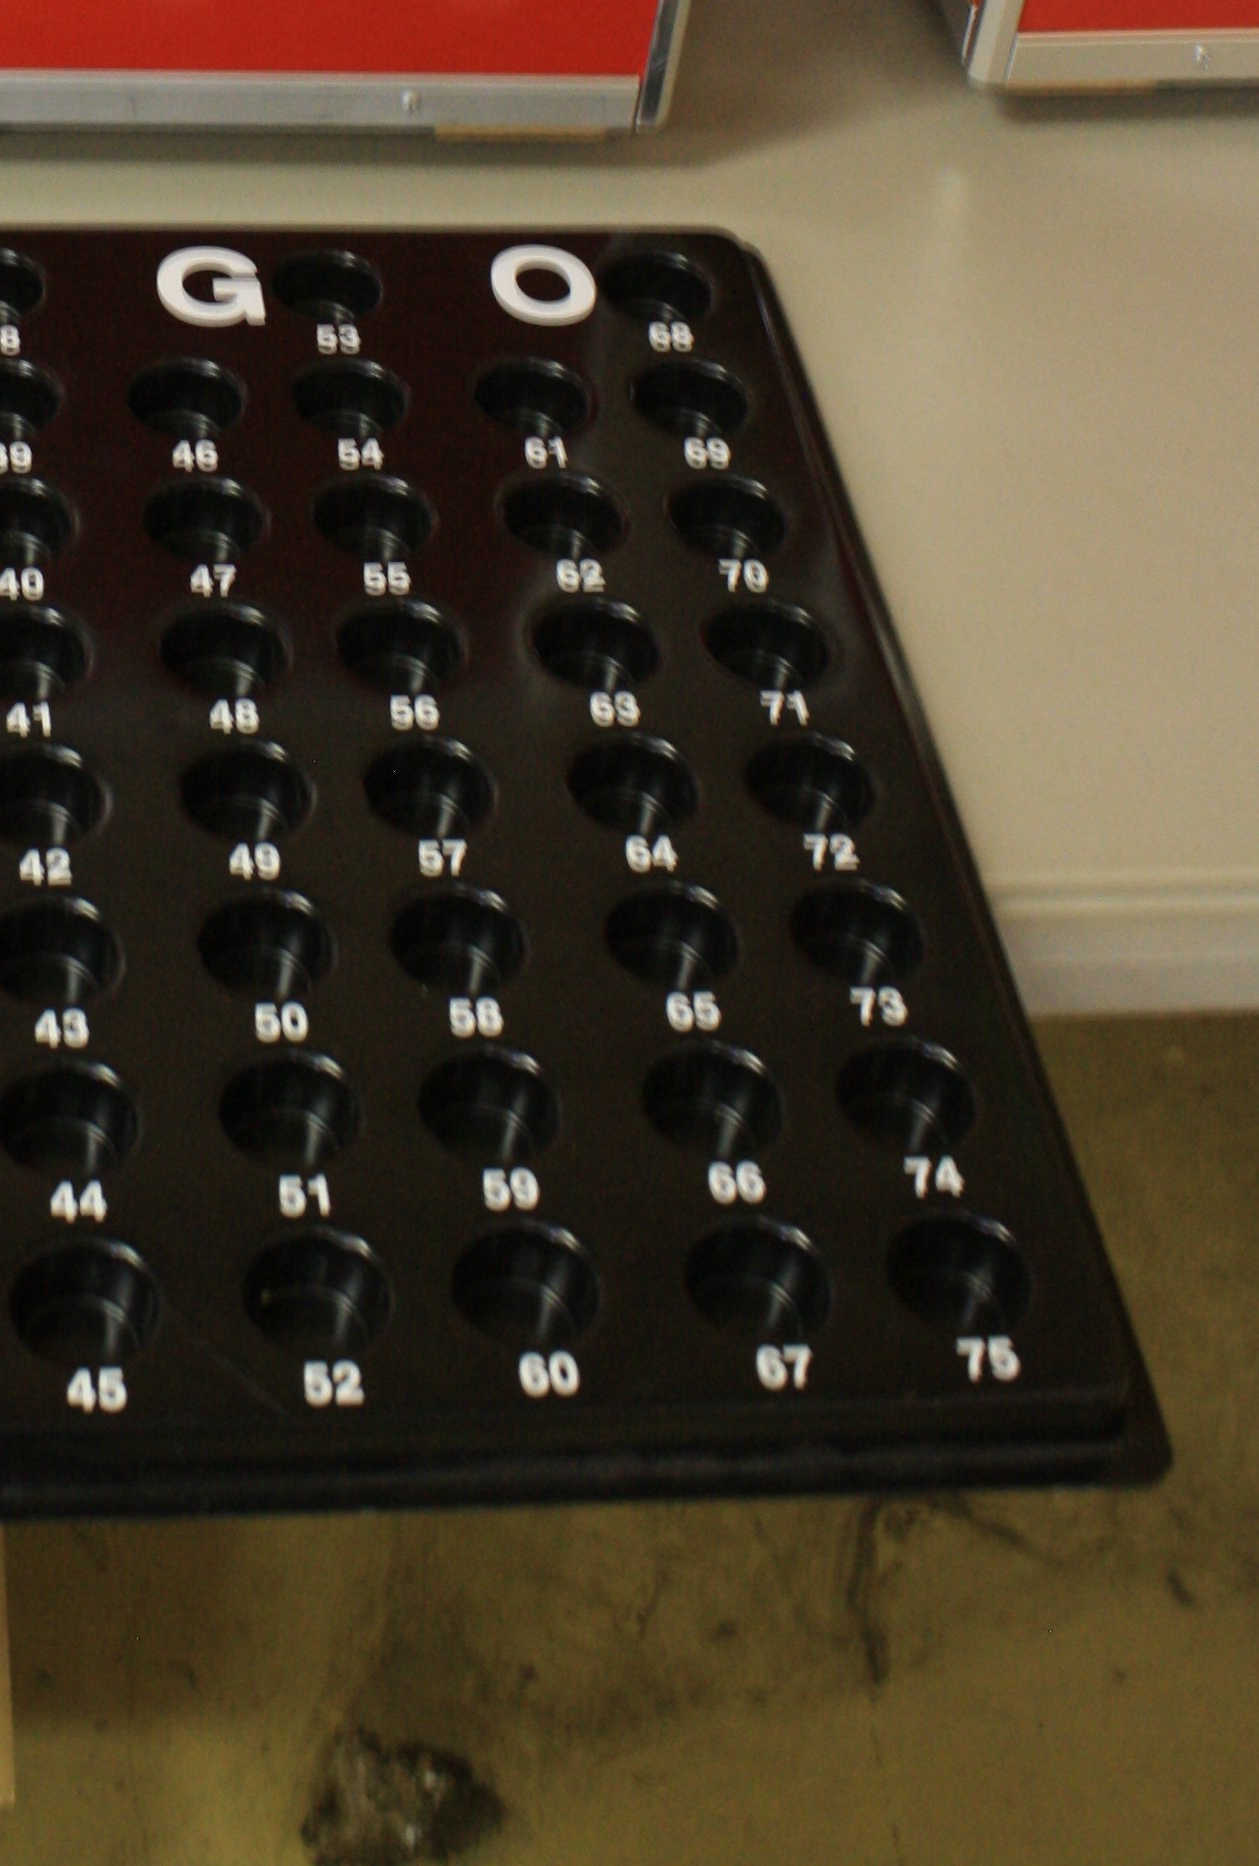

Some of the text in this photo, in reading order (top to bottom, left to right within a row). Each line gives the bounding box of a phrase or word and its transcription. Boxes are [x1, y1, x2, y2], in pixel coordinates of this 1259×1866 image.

[155, 246, 267, 324] G
[489, 244, 596, 322] O
[316, 324, 361, 351] 53
[172, 439, 218, 471] 46
[337, 438, 384, 468] 54
[524, 437, 567, 467] 61
[684, 437, 730, 466] 69
[190, 564, 236, 596] 47
[363, 562, 411, 594] 55
[556, 559, 605, 591] 62
[719, 560, 767, 590] 70
[6, 702, 52, 735] 41
[209, 698, 260, 732] 48
[390, 695, 440, 729] 56
[589, 691, 640, 725] 63
[761, 691, 808, 723] 71
[19, 848, 72, 884] 42
[229, 843, 281, 878] 49
[418, 840, 467, 874] 57
[625, 836, 677, 870] 64
[804, 834, 858, 868] 72
[254, 1003, 308, 1040] 50
[449, 998, 503, 1035] 58
[666, 992, 721, 1029] 65
[851, 987, 907, 1023] 73
[34, 1009, 90, 1046] 43
[482, 1168, 539, 1208] 59
[708, 1162, 765, 1201] 66
[905, 1157, 963, 1195] 74
[50, 1181, 107, 1219] 44
[278, 1175, 330, 1215] 51
[519, 1352, 579, 1394] 60
[756, 1345, 811, 1387] 67
[957, 1337, 1019, 1378] 75
[67, 1368, 127, 1410] 45
[303, 1361, 364, 1404] 52
